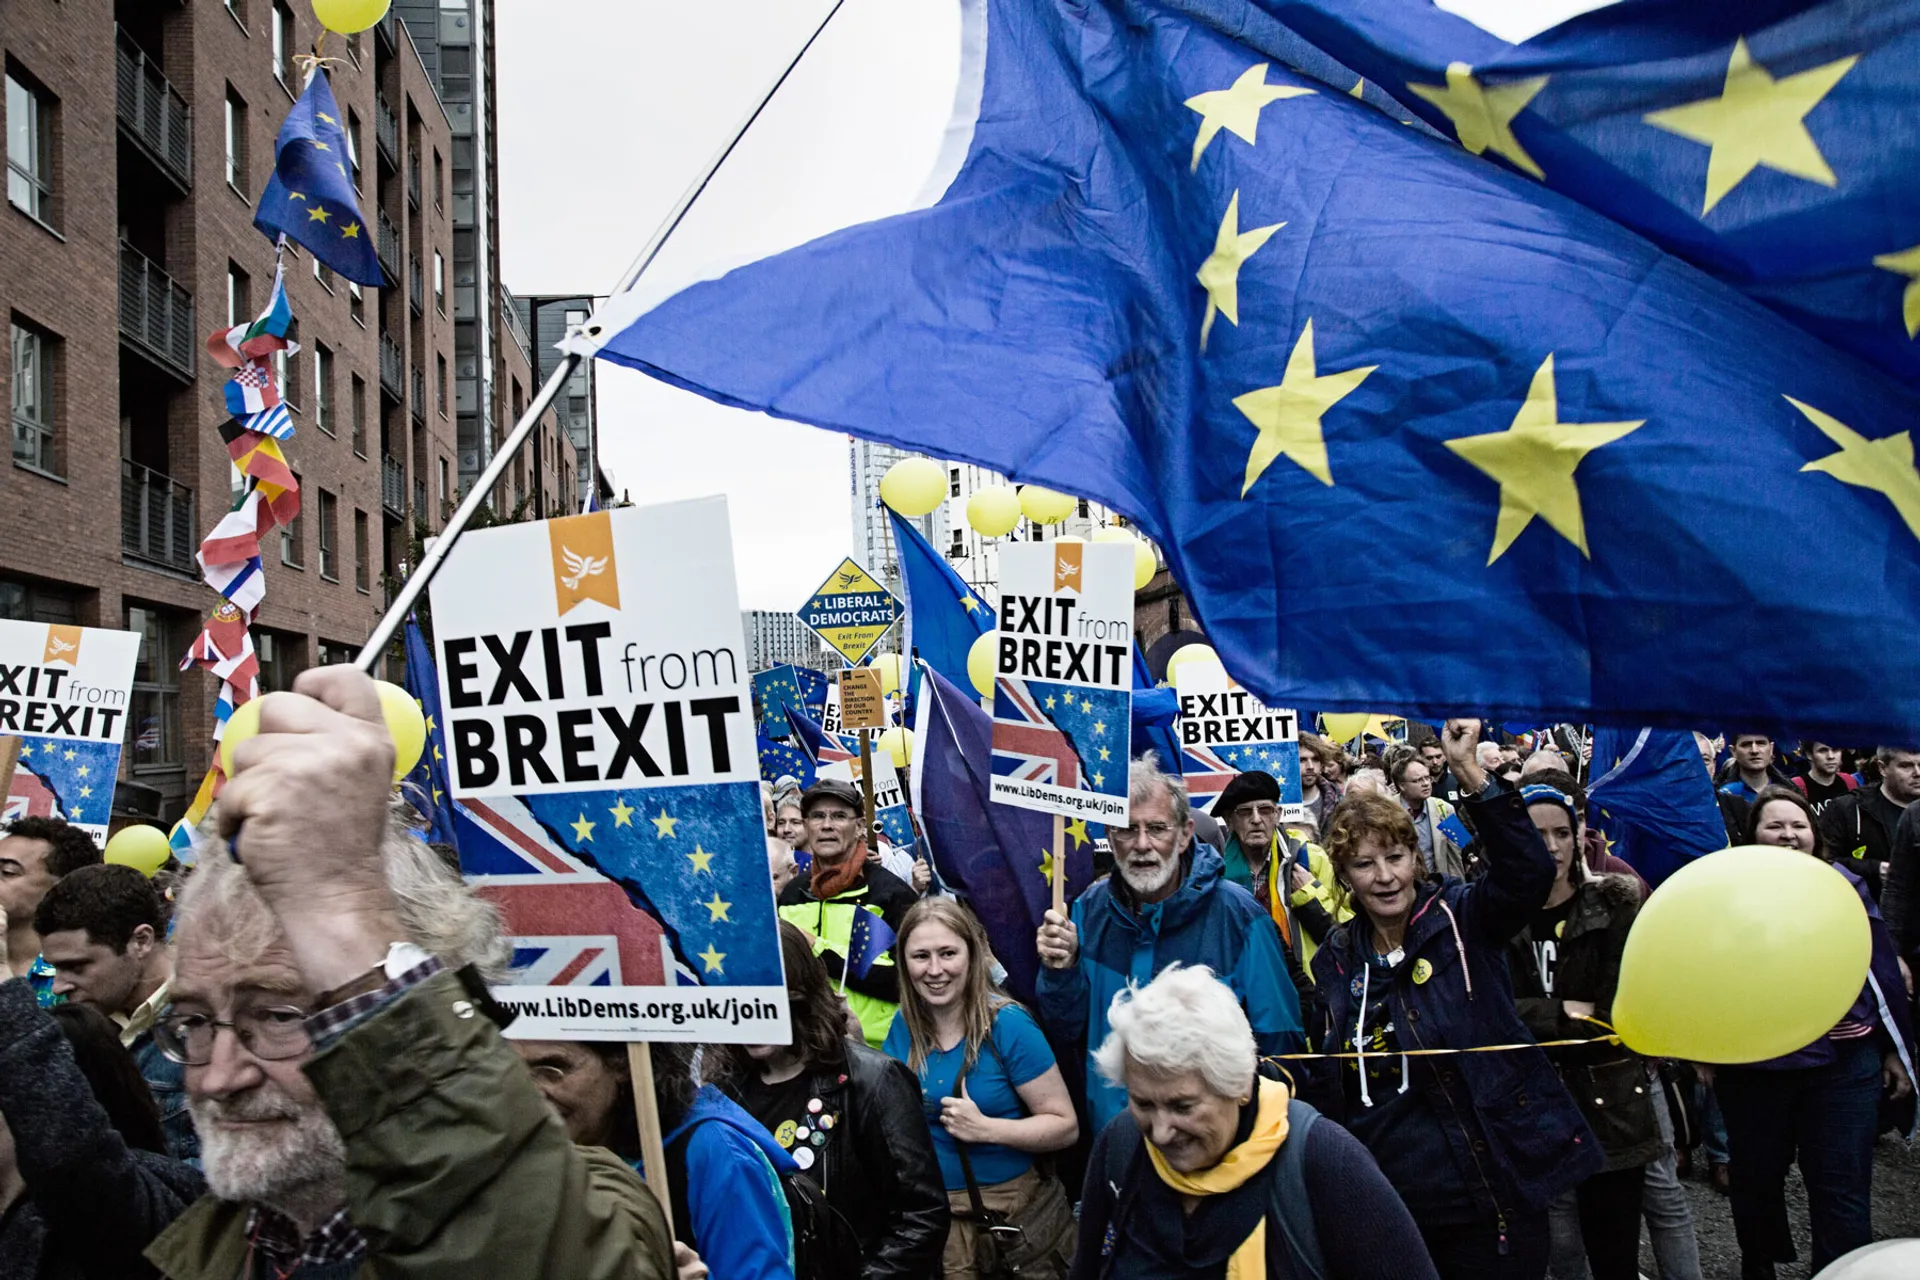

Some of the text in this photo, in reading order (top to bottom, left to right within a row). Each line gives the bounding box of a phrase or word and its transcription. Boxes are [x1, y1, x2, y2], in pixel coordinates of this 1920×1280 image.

[824, 595, 882, 610] LIBERAL
[809, 610, 893, 626] DEMOCRATS
[1000, 595, 1129, 641] EXIT from
[837, 632, 874, 640] Exit From
[843, 642, 866, 650] Brexit
[443, 621, 738, 710] EXIT from
[998, 636, 1128, 686] BREXIT
[0, 664, 126, 705] XIT from
[0, 698, 122, 739] REXIT
[1180, 692, 1249, 719] EXIT
[452, 696, 740, 791] BREXIT
[1182, 715, 1293, 745] BREXIT
[874, 778, 898, 791] rom
[994, 782, 1124, 815] www.LibDems.org.uk/join
[498, 998, 778, 1025] ww.LibDems.org.uk/join
